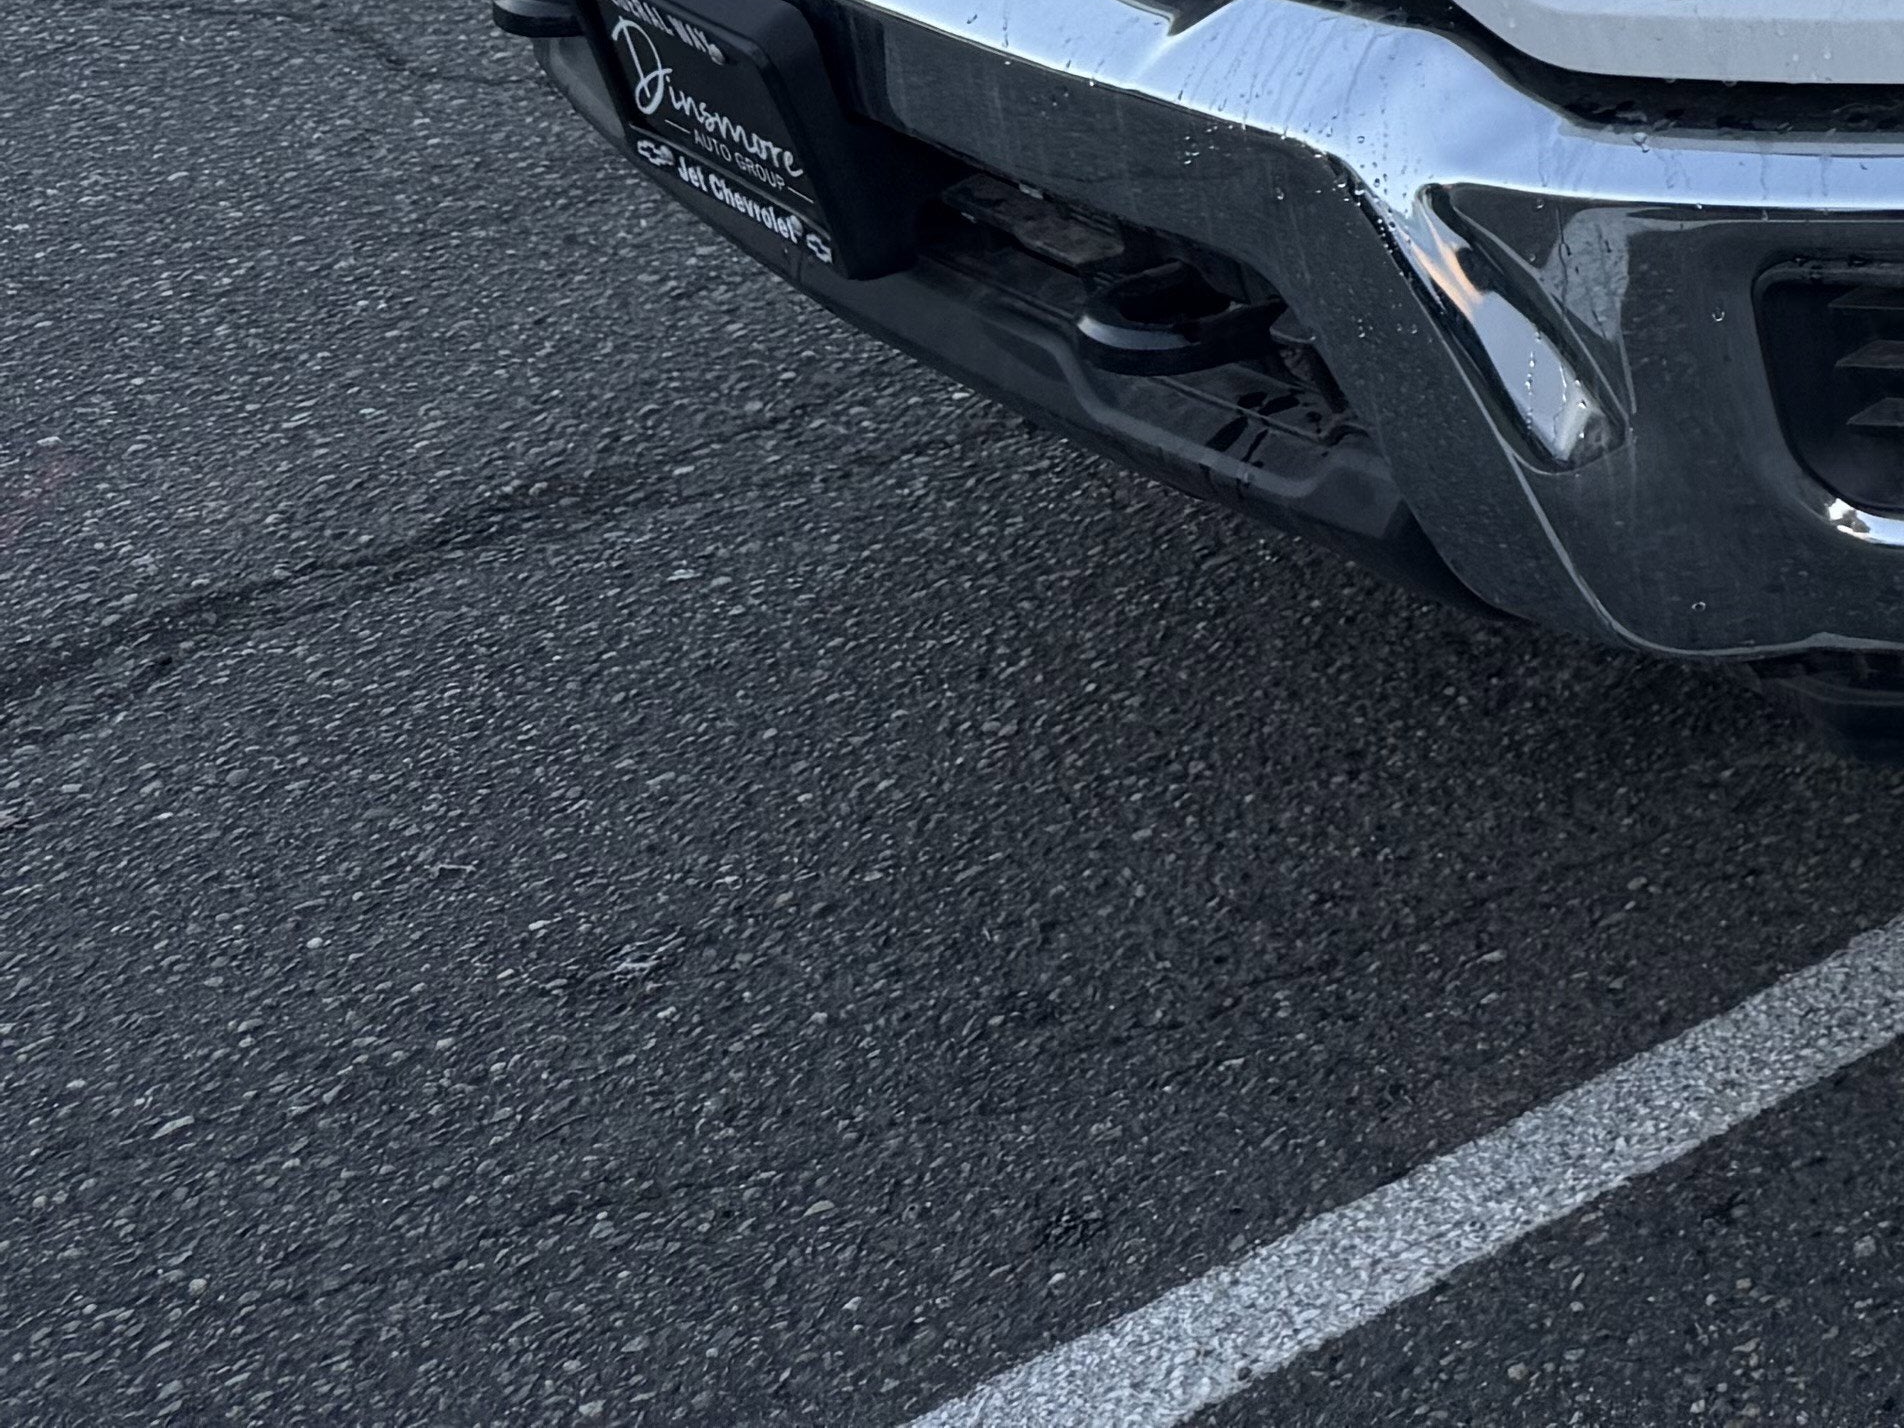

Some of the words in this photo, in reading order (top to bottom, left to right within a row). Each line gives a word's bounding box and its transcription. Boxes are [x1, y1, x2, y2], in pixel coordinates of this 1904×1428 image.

[611, 16, 803, 178] Dinsmore
[677, 156, 708, 192] Jet
[708, 173, 800, 244] Chevrolet
[693, 128, 732, 162] AUTO
[734, 152, 786, 191] GROUP
